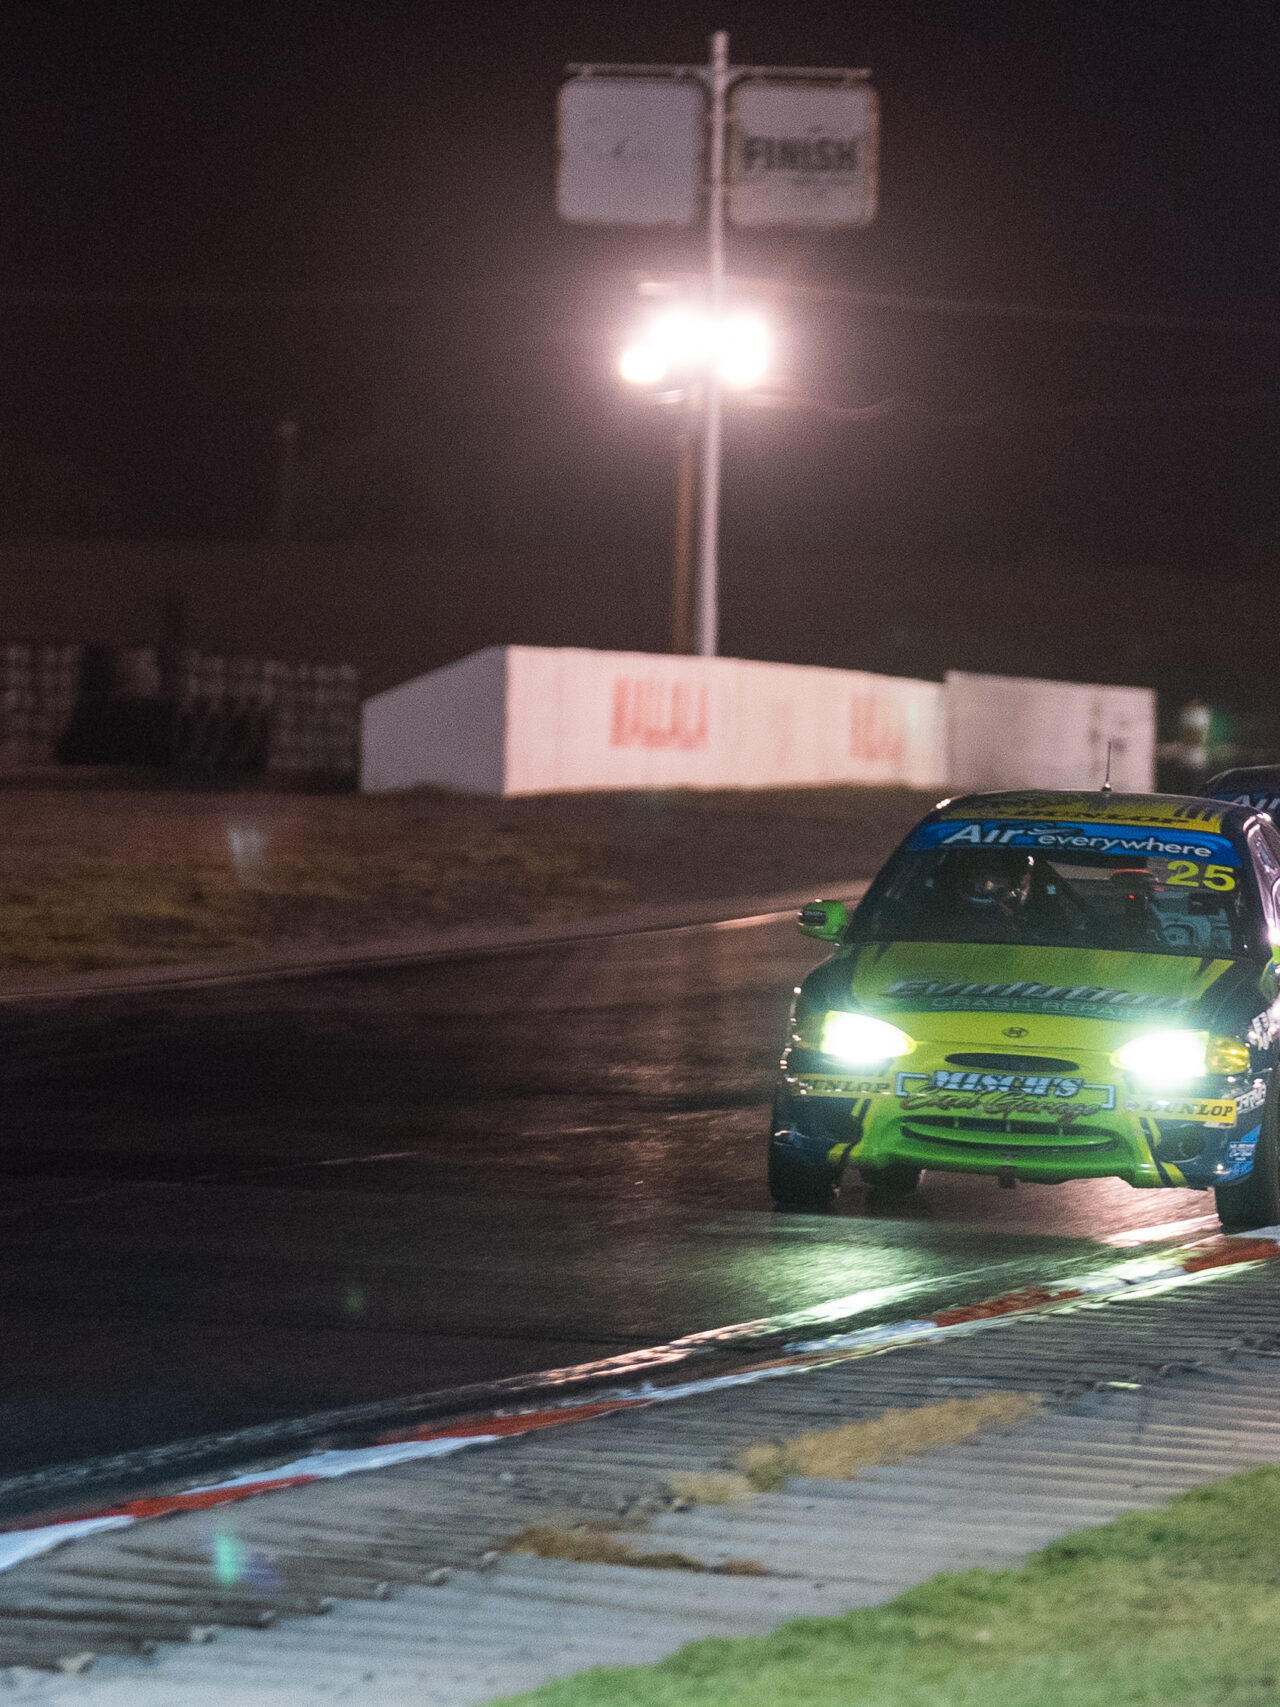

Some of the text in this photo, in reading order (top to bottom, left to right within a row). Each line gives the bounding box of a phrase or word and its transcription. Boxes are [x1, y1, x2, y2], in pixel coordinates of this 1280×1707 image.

[744, 136, 858, 172] FINISH
[943, 821, 1213, 858] Air everywhere
[1165, 859, 1237, 892] 25
[1144, 1102, 1234, 1117] DUNLOP
